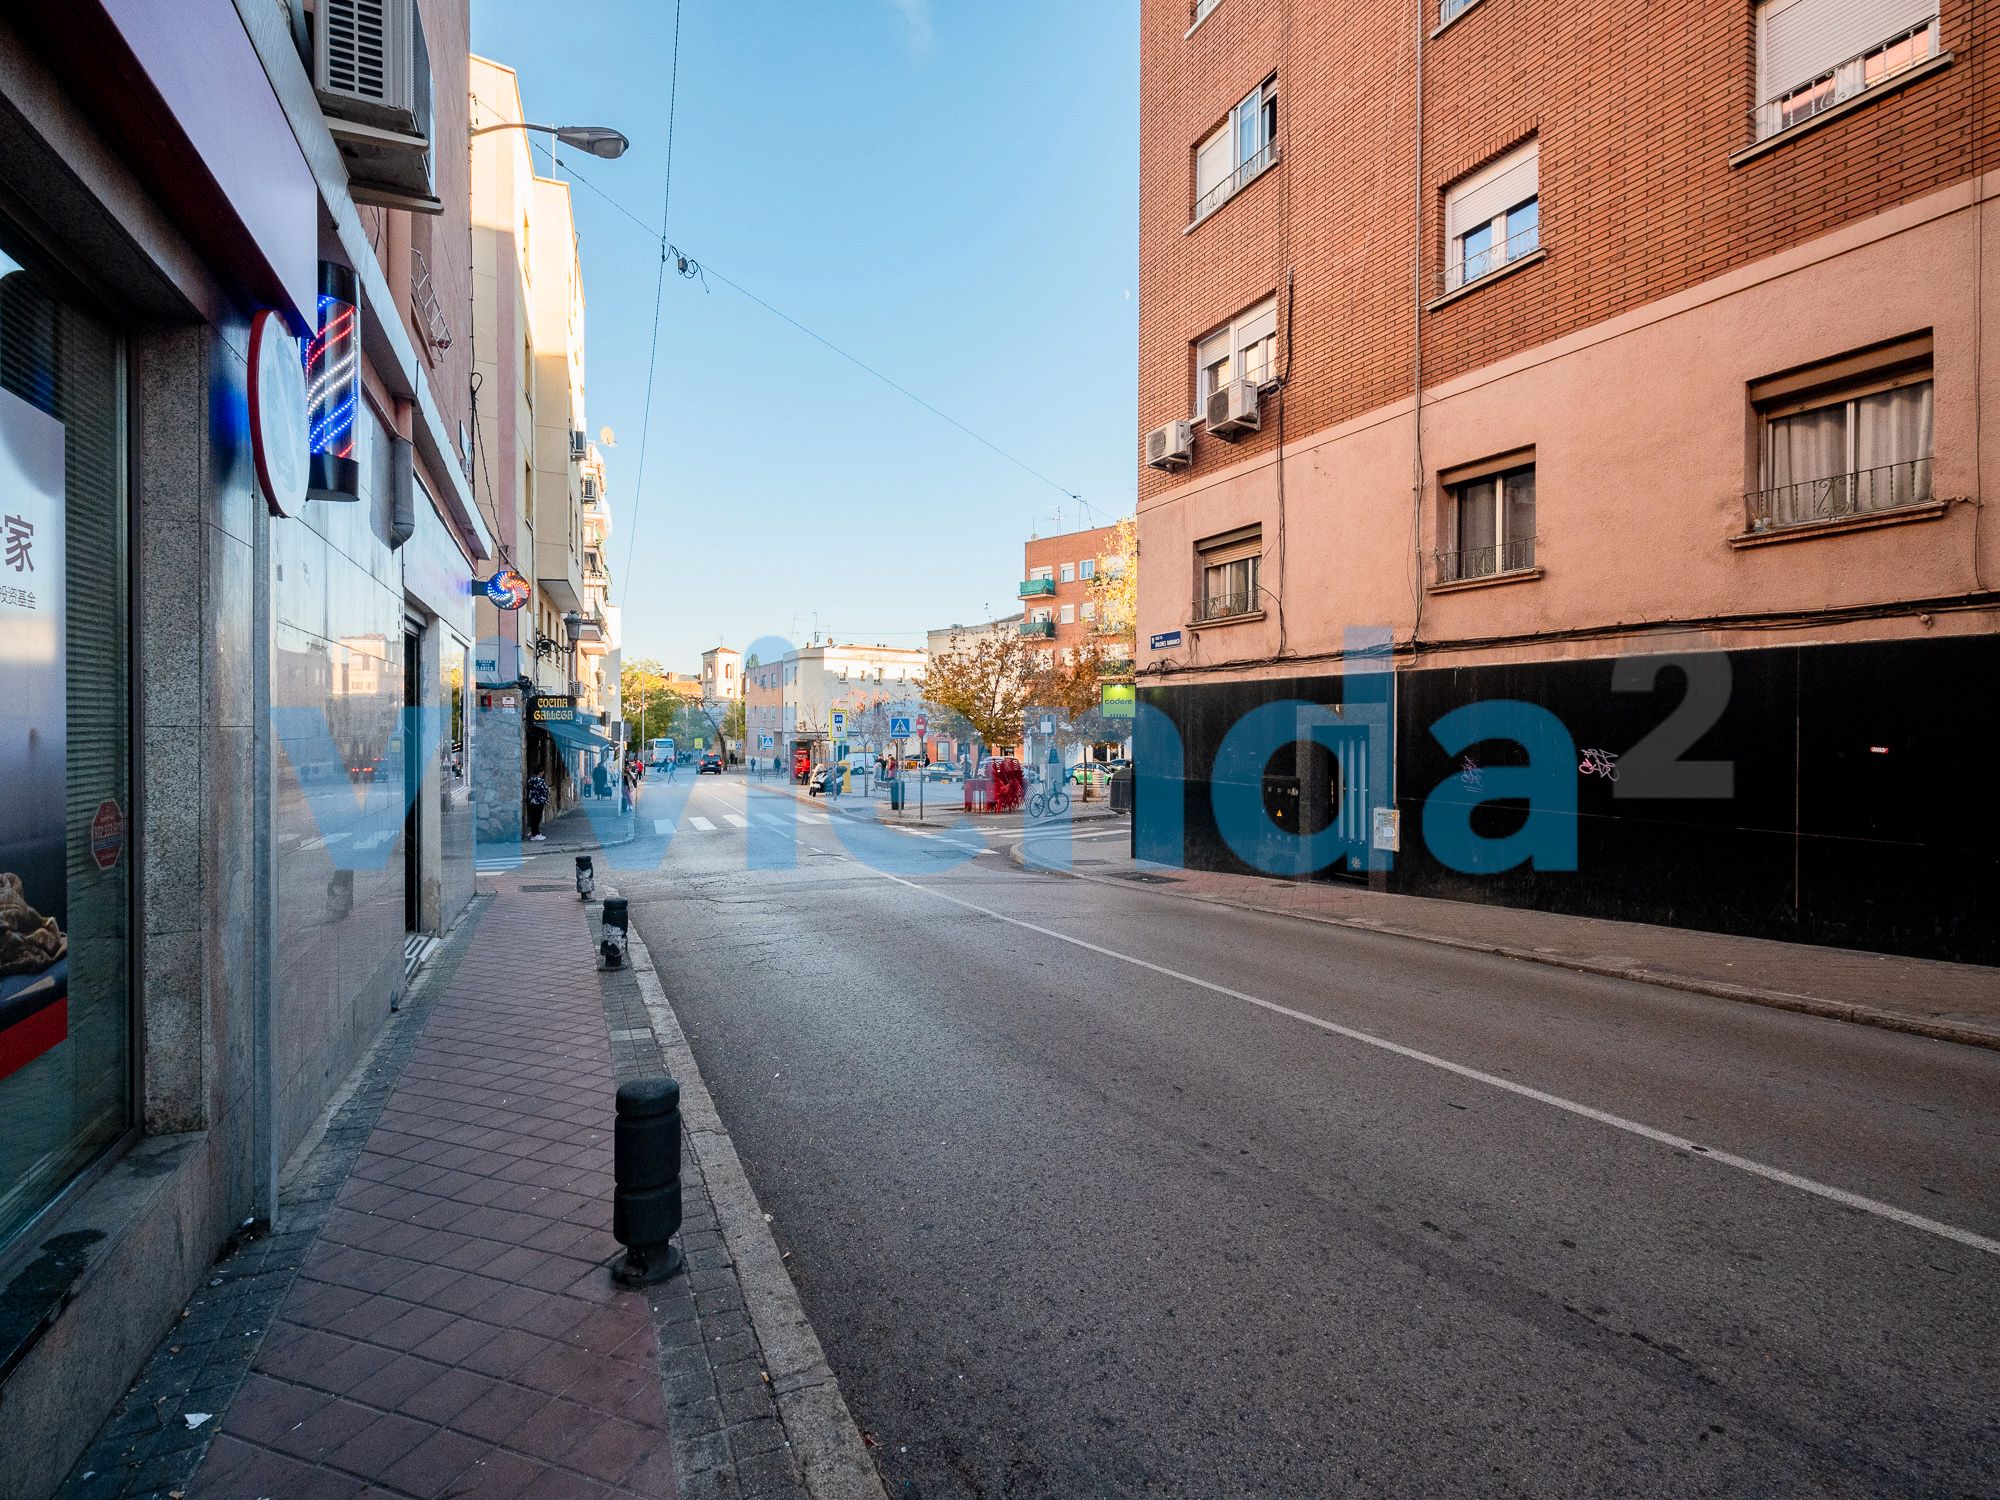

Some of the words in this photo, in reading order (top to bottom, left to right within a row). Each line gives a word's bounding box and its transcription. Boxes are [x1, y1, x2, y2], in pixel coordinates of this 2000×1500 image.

[0, 514, 34, 573] 家
[537, 698, 568, 708] COCINA
[533, 710, 573, 721] GALLEGA
